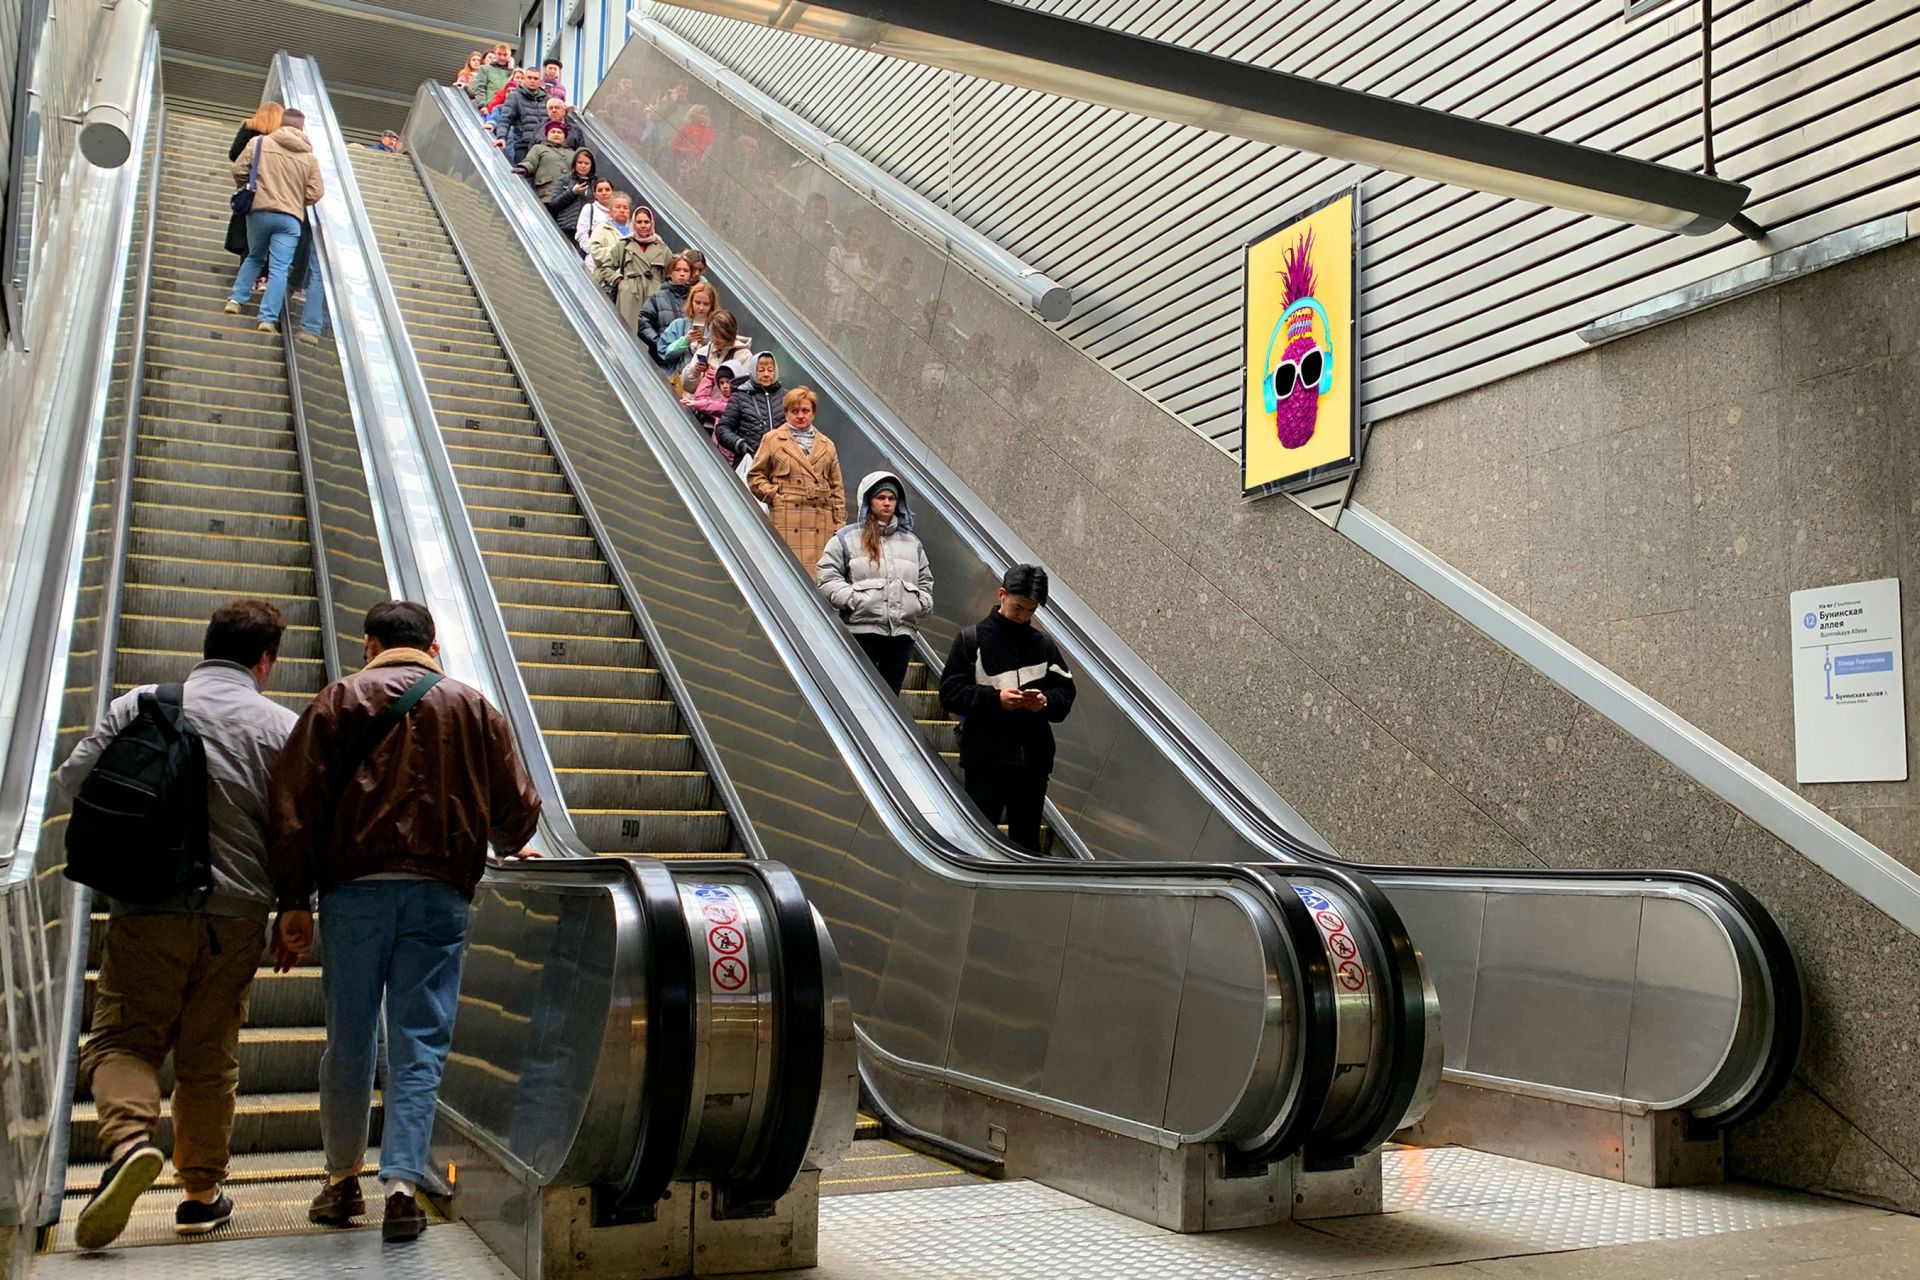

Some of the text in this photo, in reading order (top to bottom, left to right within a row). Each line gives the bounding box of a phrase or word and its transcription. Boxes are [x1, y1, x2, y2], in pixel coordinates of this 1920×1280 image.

[1805, 615, 1815, 626] 12
[1820, 608, 1863, 621] Бунинская
[1820, 620, 1844, 630] аллея
[622, 819, 640, 837] 90
